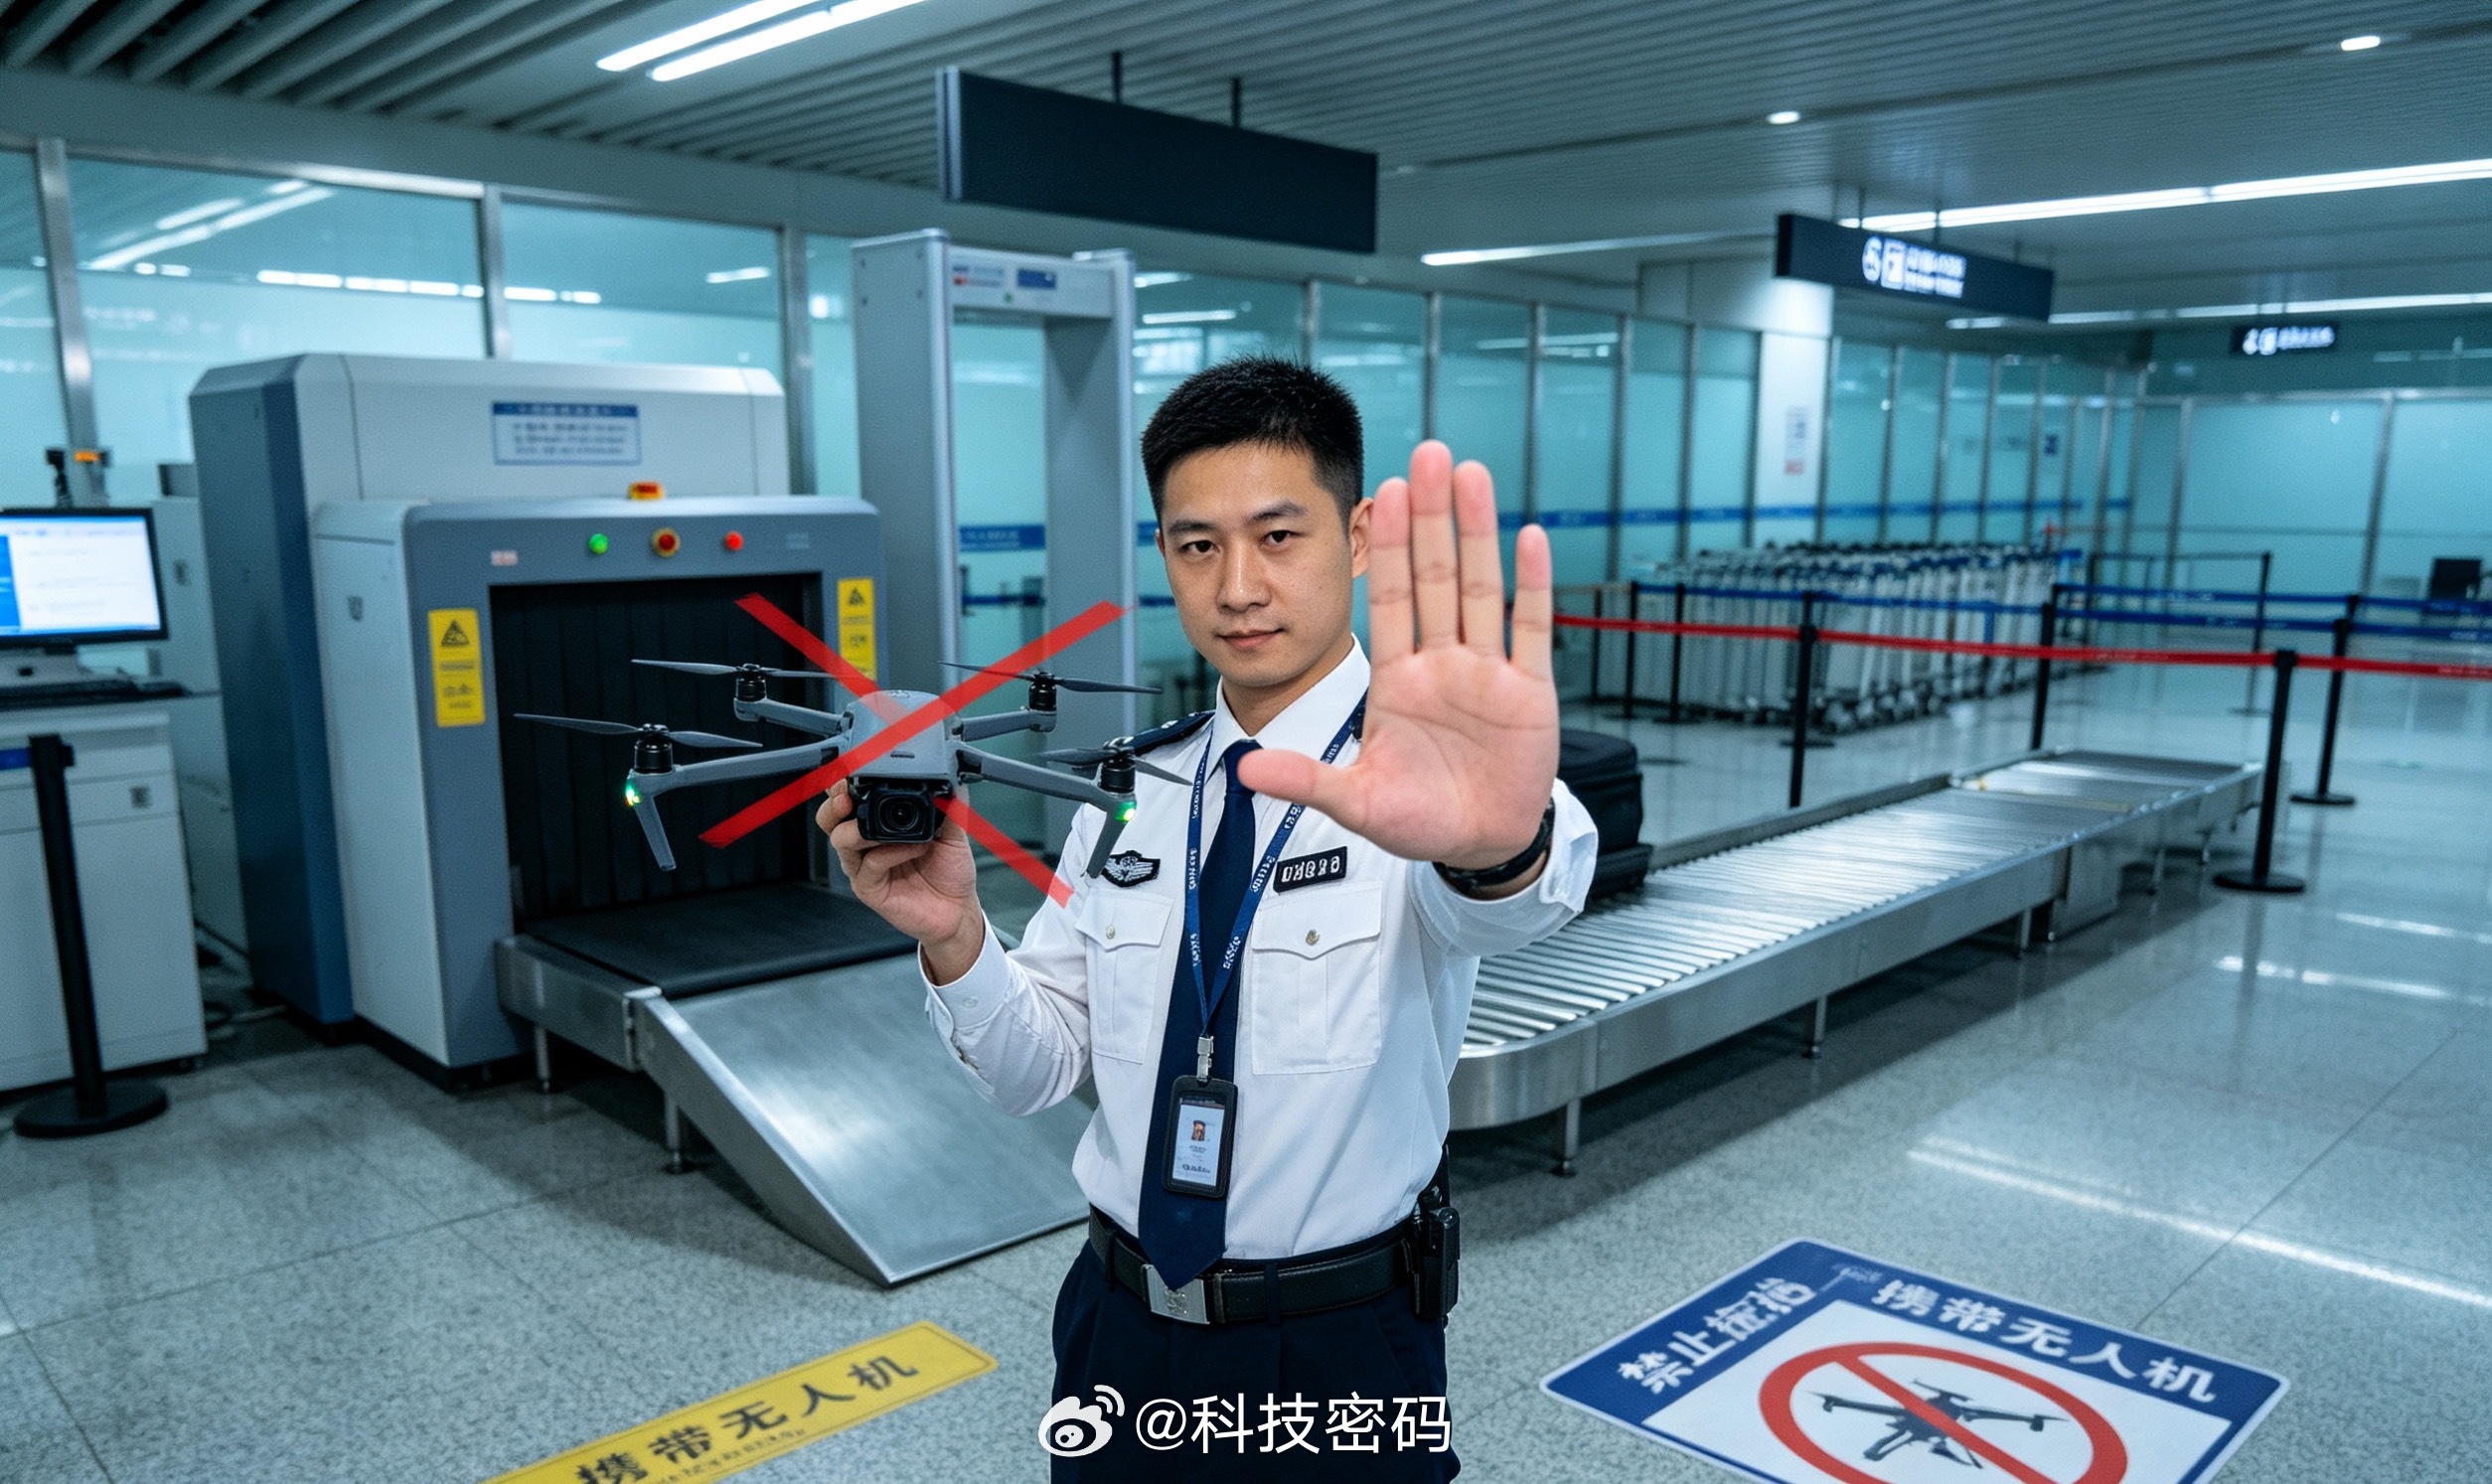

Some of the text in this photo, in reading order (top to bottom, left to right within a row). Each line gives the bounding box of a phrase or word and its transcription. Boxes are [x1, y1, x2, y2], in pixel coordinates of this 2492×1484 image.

[1871, 1278, 2217, 1403] 携带无人机
[574, 1355, 920, 1484] 携带无人机
